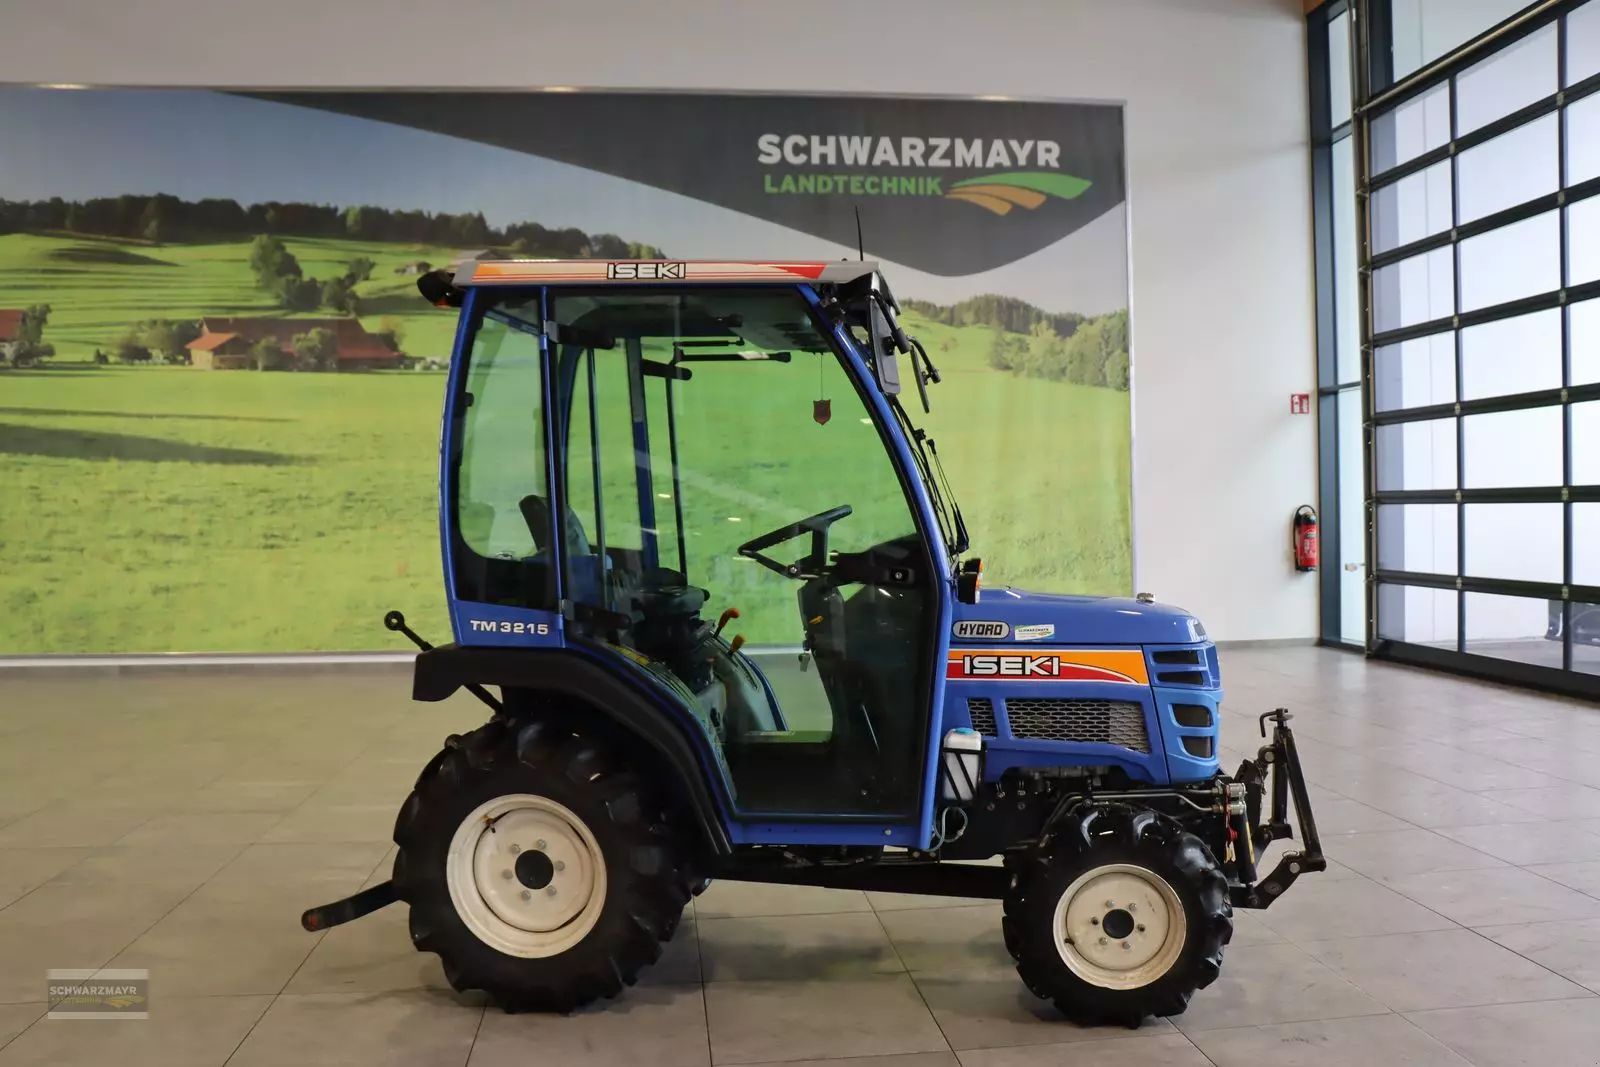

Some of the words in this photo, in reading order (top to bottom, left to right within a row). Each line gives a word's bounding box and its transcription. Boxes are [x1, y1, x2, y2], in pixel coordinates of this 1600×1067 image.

[757, 133, 1061, 169] SCHWARZMAYR
[764, 173, 943, 196] LANDTECHNIK
[607, 262, 687, 280] ISEKI
[470, 620, 496, 631] TM
[500, 622, 548, 634] 3215
[959, 623, 1003, 636] HYDRO
[963, 655, 1060, 676] ISEKI
